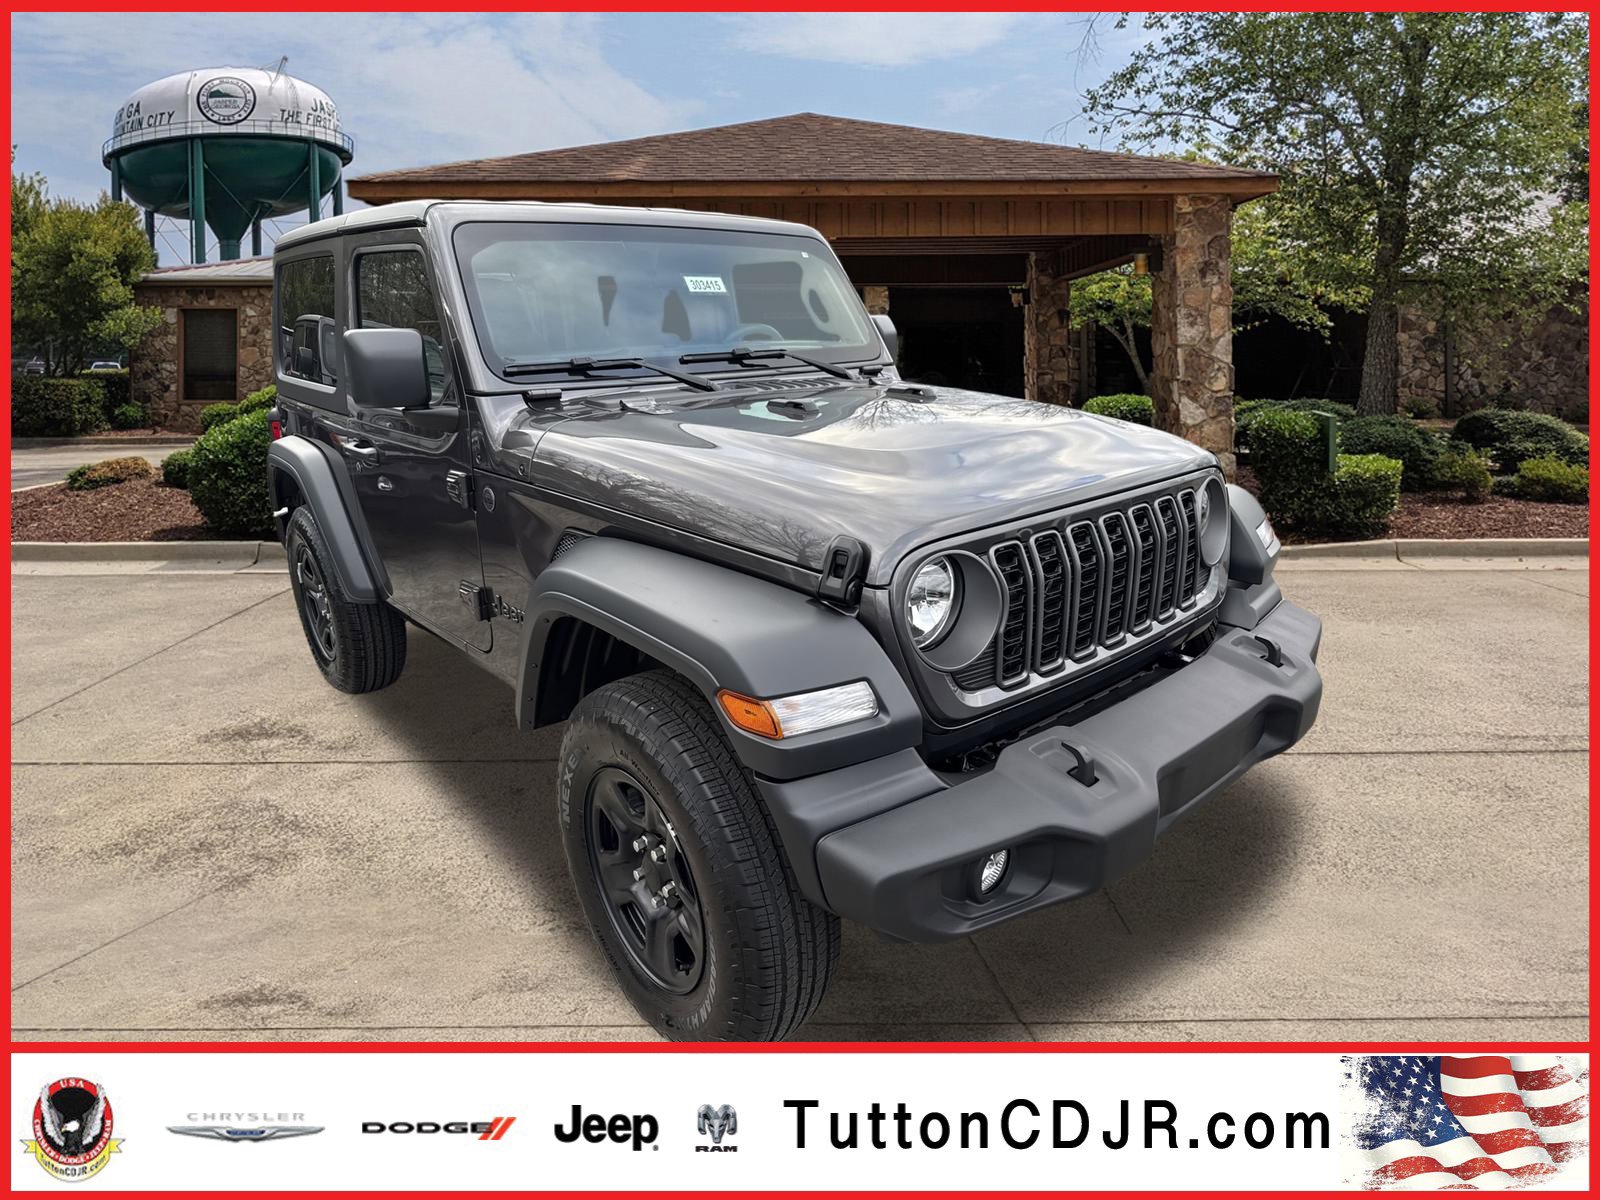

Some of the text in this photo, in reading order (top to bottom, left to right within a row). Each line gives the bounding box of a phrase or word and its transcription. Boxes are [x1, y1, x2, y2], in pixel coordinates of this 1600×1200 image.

[126, 100, 141, 119] GA
[280, 108, 302, 124] THE
[147, 110, 175, 127] CITY
[689, 279, 721, 291] 303415
